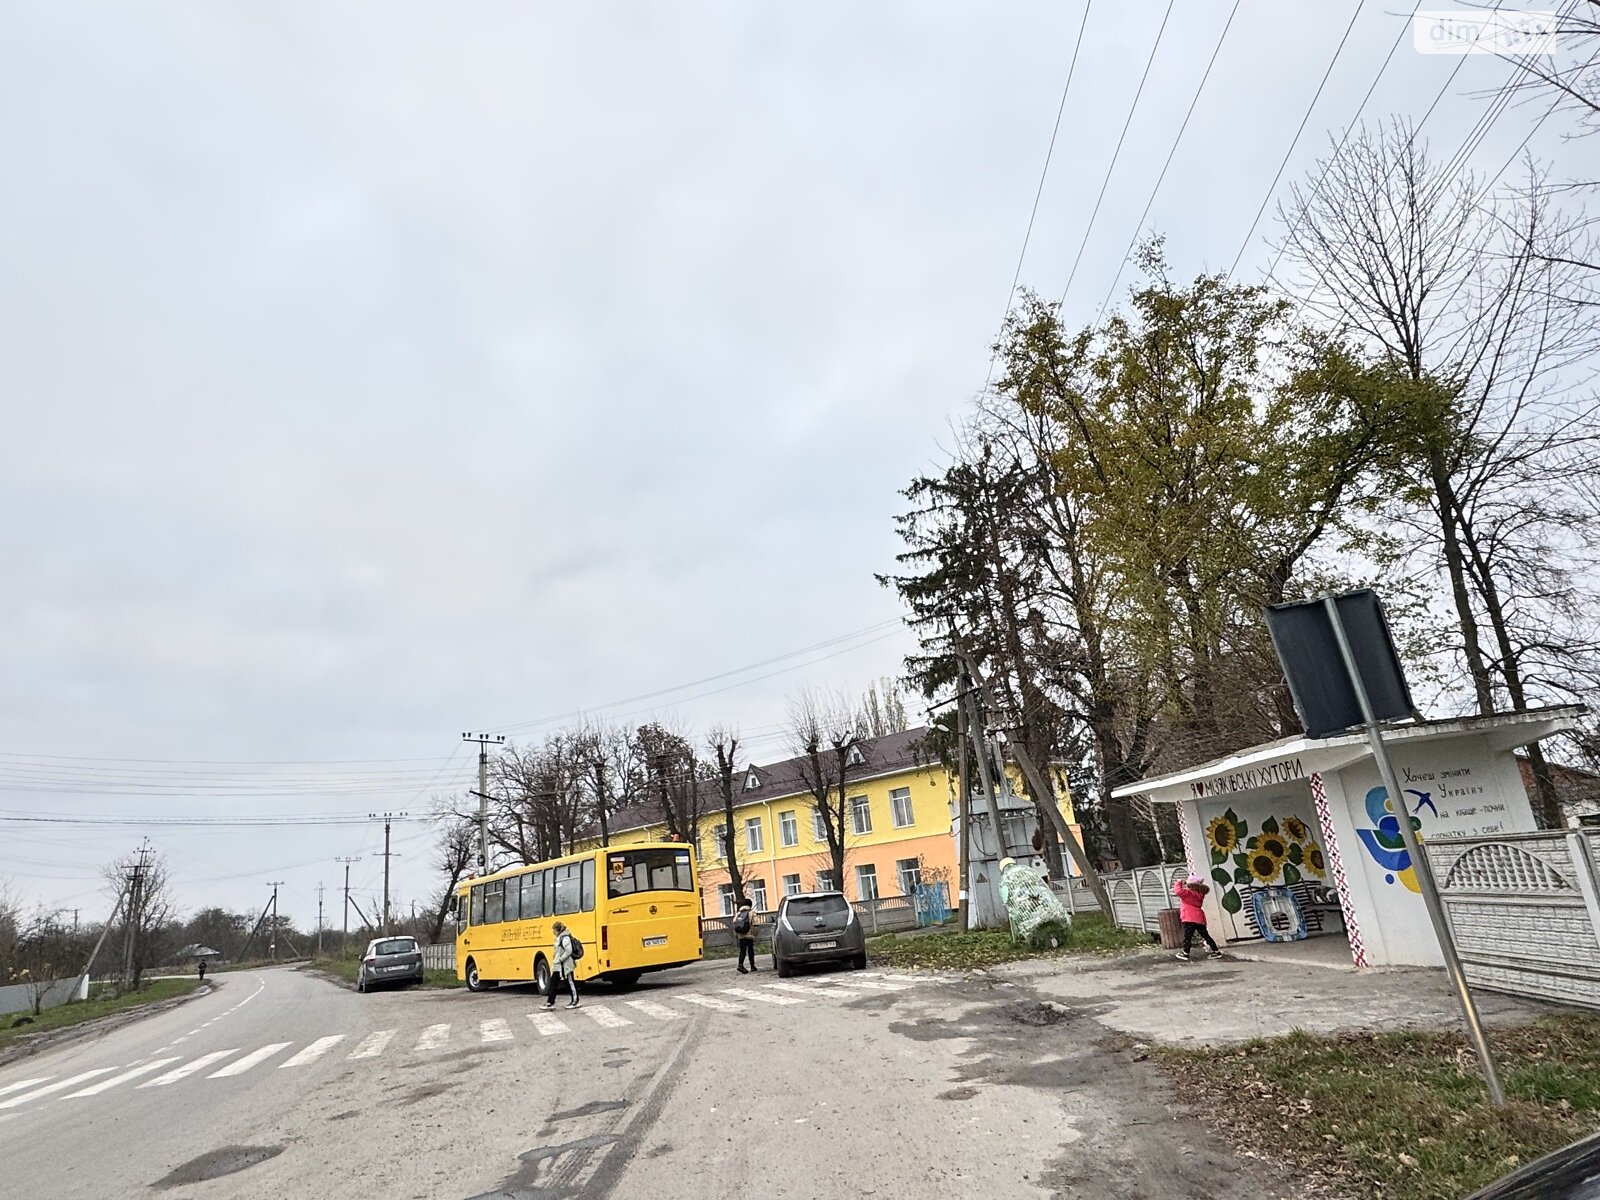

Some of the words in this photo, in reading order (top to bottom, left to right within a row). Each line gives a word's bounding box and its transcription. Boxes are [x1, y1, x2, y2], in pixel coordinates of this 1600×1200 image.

[1257, 758, 1305, 785] ХУТОРИ
[1402, 767, 1435, 783] Хочеш
[1441, 768, 1471, 779] змінити
[1440, 811, 1449, 819] на
